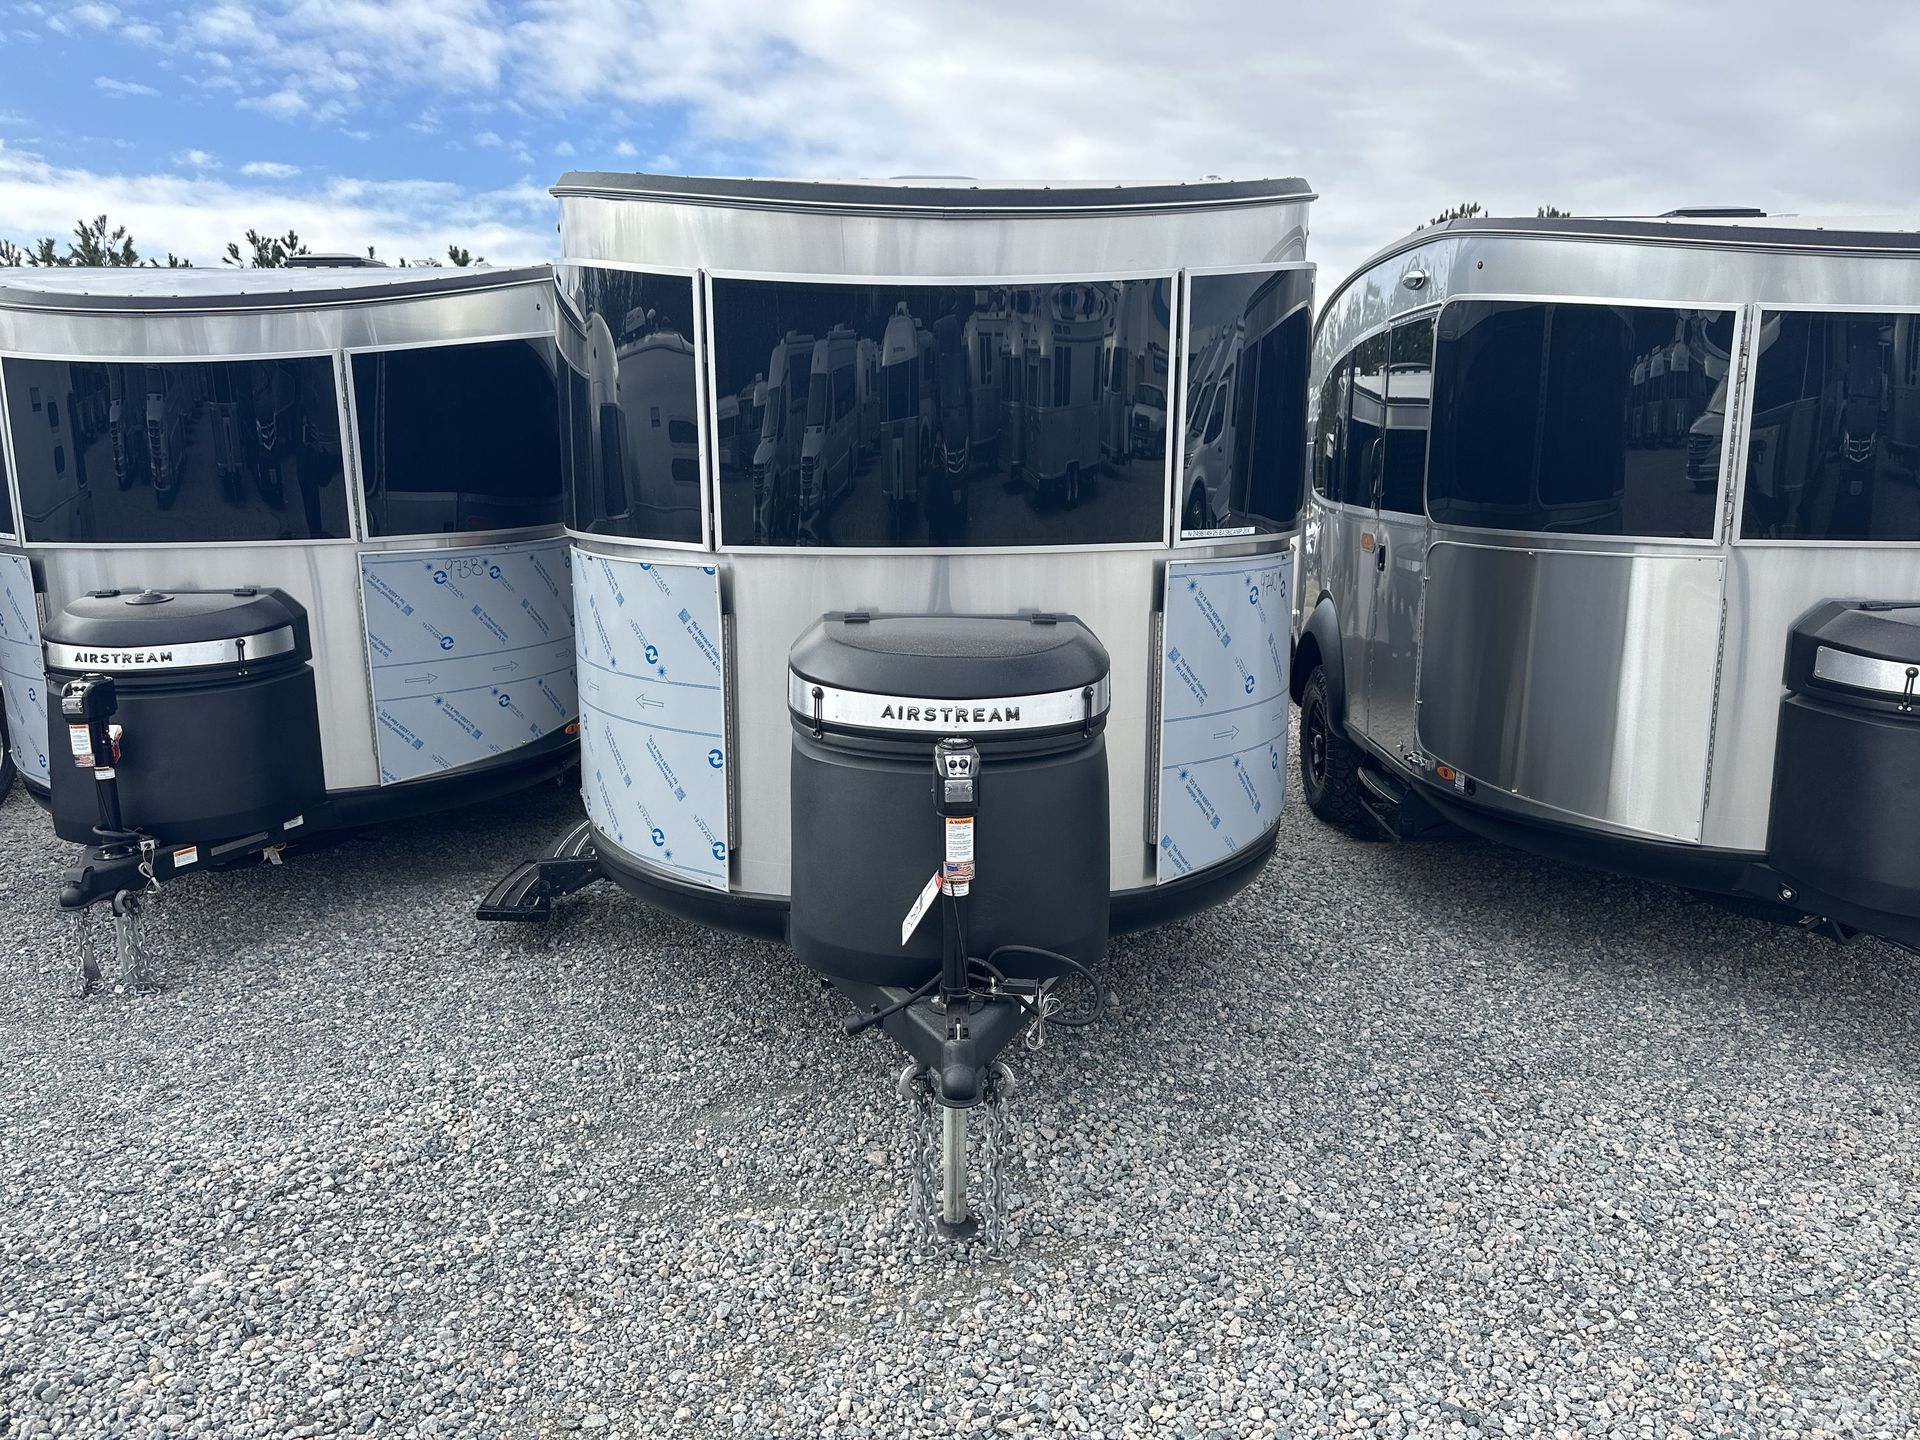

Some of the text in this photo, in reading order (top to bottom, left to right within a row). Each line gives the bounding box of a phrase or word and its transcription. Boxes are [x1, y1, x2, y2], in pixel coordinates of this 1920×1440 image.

[445, 558, 483, 580] 9738
[649, 566, 672, 596] NOVACEL
[74, 652, 173, 664] AIRSTREAM
[881, 704, 1020, 723] AIRSTREAM
[637, 801, 653, 830] NOVACEL
[693, 814, 714, 845] NOVACEL
